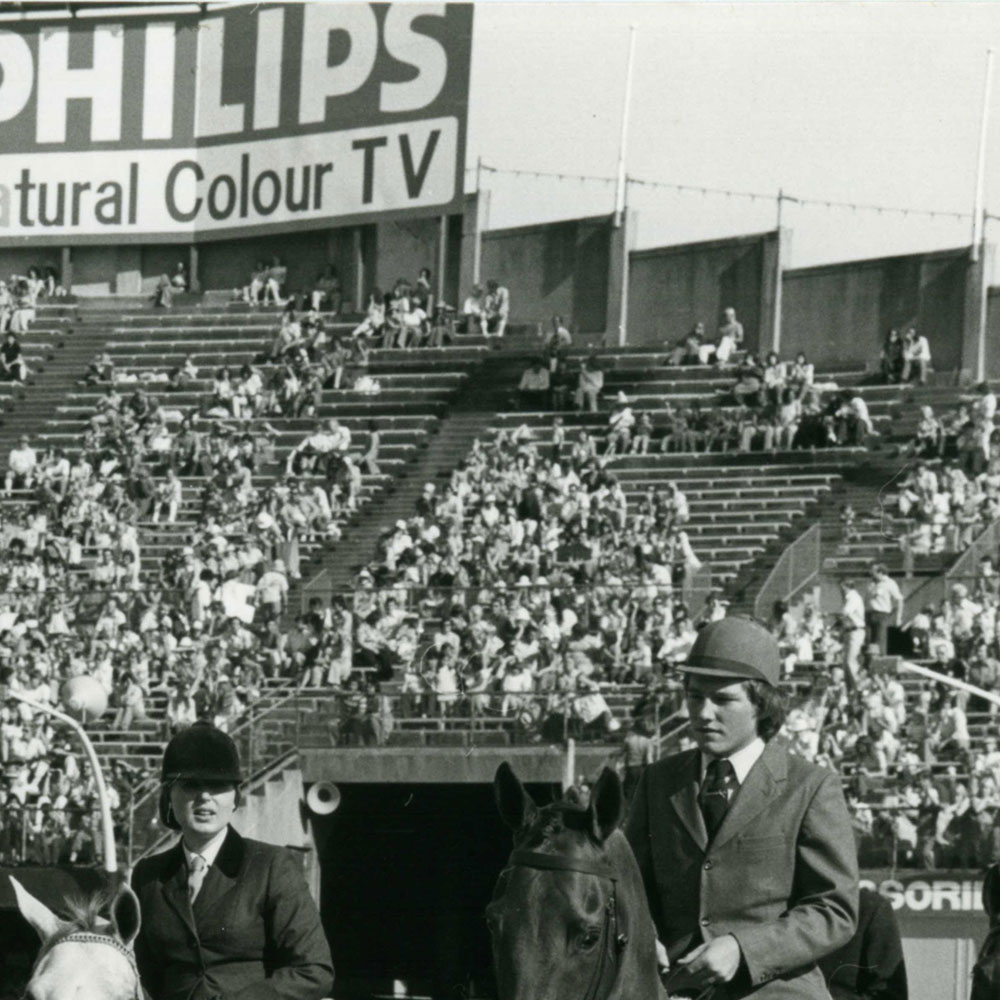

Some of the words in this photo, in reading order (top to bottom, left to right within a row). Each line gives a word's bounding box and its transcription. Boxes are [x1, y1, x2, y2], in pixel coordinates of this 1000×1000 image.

[164, 153, 333, 223] Colour
[352, 129, 442, 204] TV
[859, 880, 985, 911] SORI
